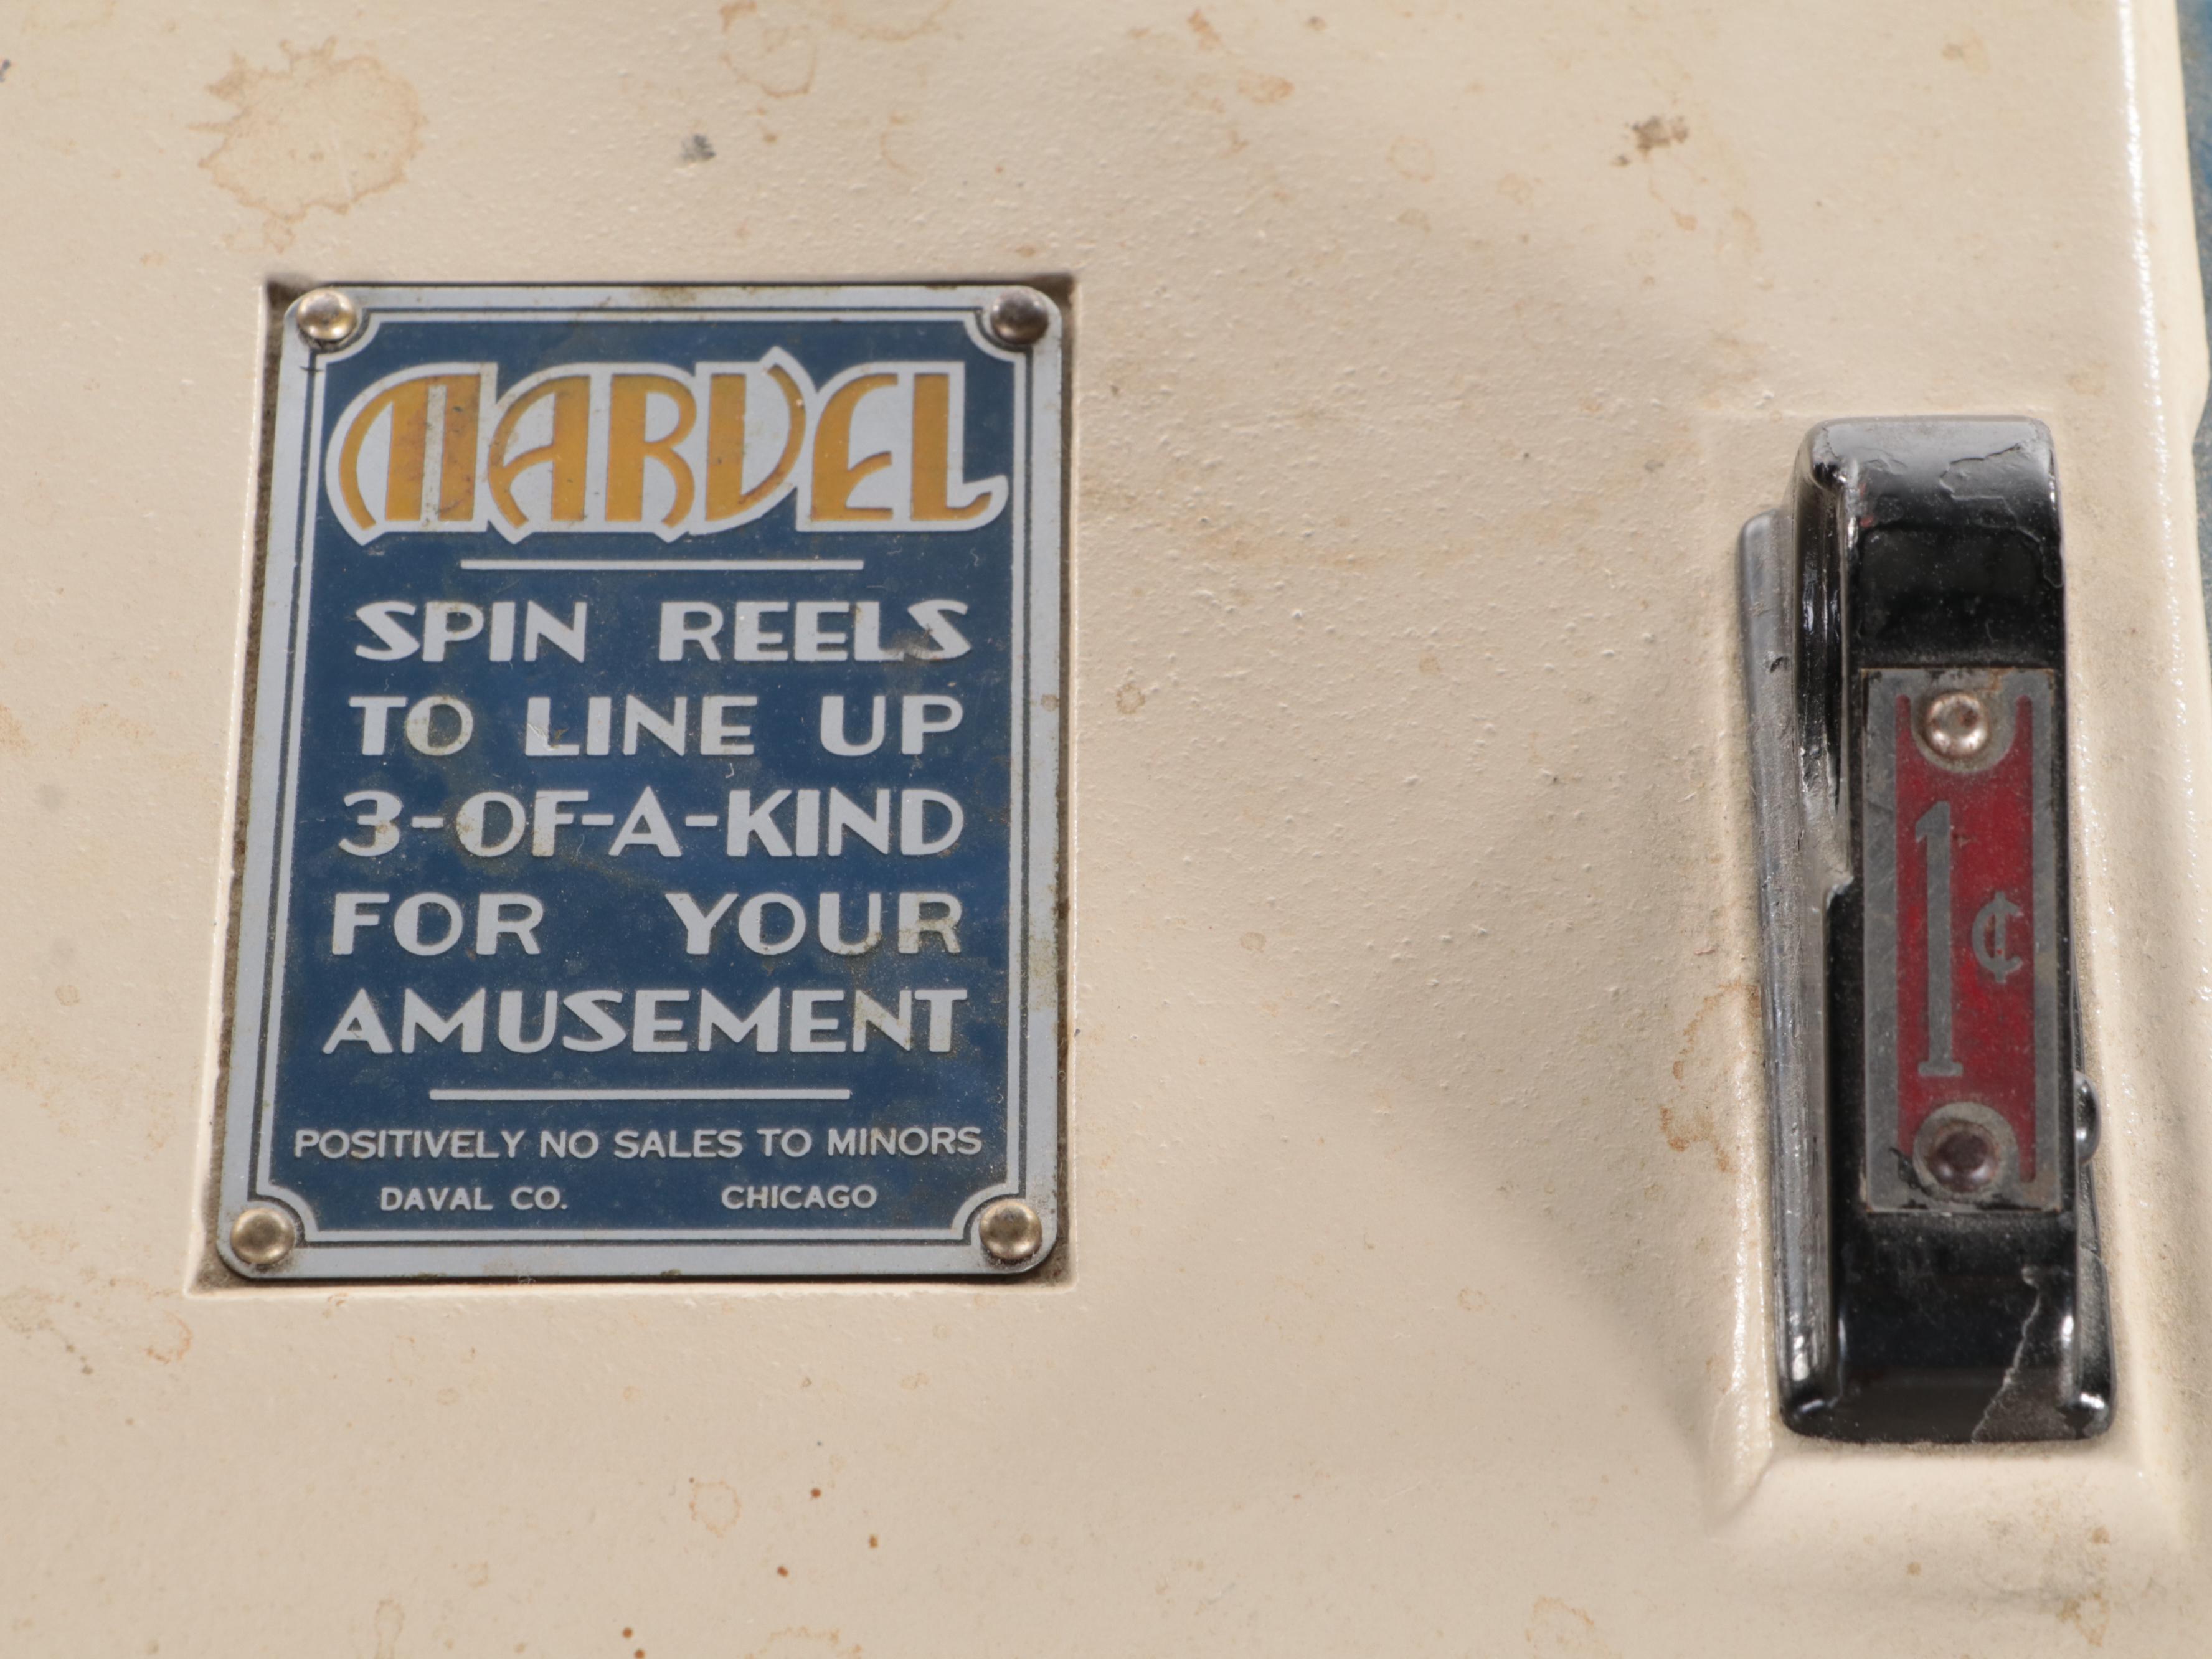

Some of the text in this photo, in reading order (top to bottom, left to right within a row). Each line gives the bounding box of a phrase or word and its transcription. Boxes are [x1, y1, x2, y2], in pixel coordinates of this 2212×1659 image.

[326, 347, 1009, 544] MARVEL
[354, 599, 972, 664] SPIN REELS
[349, 694, 963, 756] TO LINE UP
[338, 787, 964, 858] 3-OF-A-KIND
[332, 892, 963, 956] FOR YOUR
[322, 988, 968, 1054] AMUSEMENT
[294, 1125, 982, 1160] POSITIVELY NO SALES TO MINORS
[380, 1184, 877, 1211] DAVAL CO. CHICAGO
